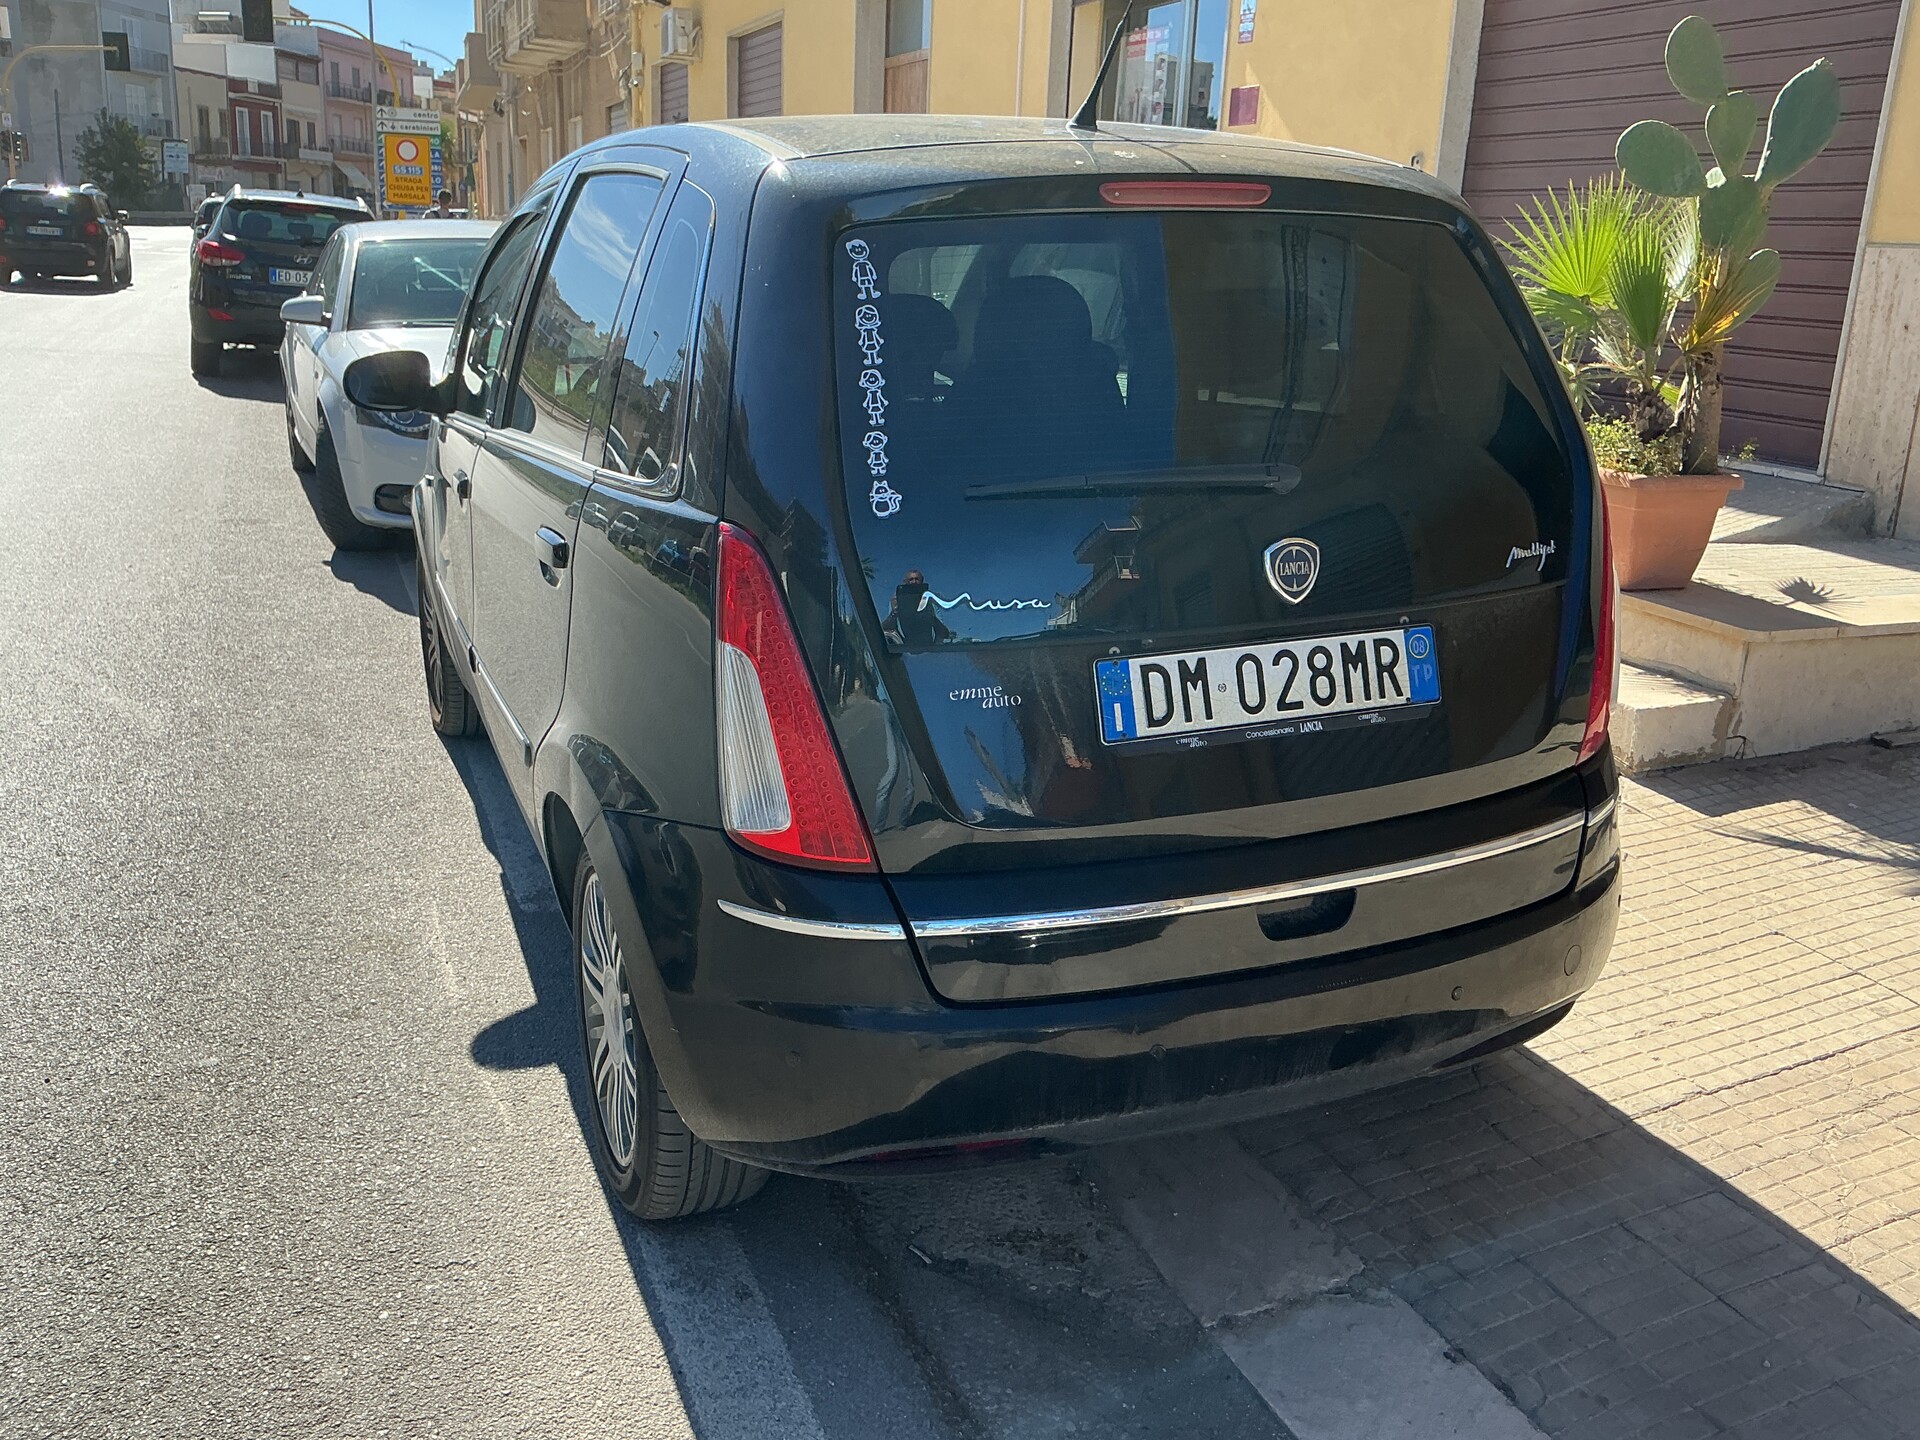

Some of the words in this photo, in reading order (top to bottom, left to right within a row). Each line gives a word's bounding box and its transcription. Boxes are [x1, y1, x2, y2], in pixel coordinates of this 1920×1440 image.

[400, 124, 439, 132] carabinieri
[394, 166, 407, 175] SS
[408, 166, 422, 175] 115
[395, 176, 423, 184] STRADA
[393, 192, 426, 200] MARSALA
[1279, 561, 1309, 576] LANCIA
[1411, 640, 1426, 654] 08
[1411, 663, 1433, 687] TP
[1139, 657, 1214, 729] DM
[1235, 637, 1405, 716] 028MR
[949, 685, 1003, 701] emme
[982, 694, 1022, 709] auto
[1245, 726, 1295, 739] Concessionaria
[1299, 720, 1323, 733] LANCIA
